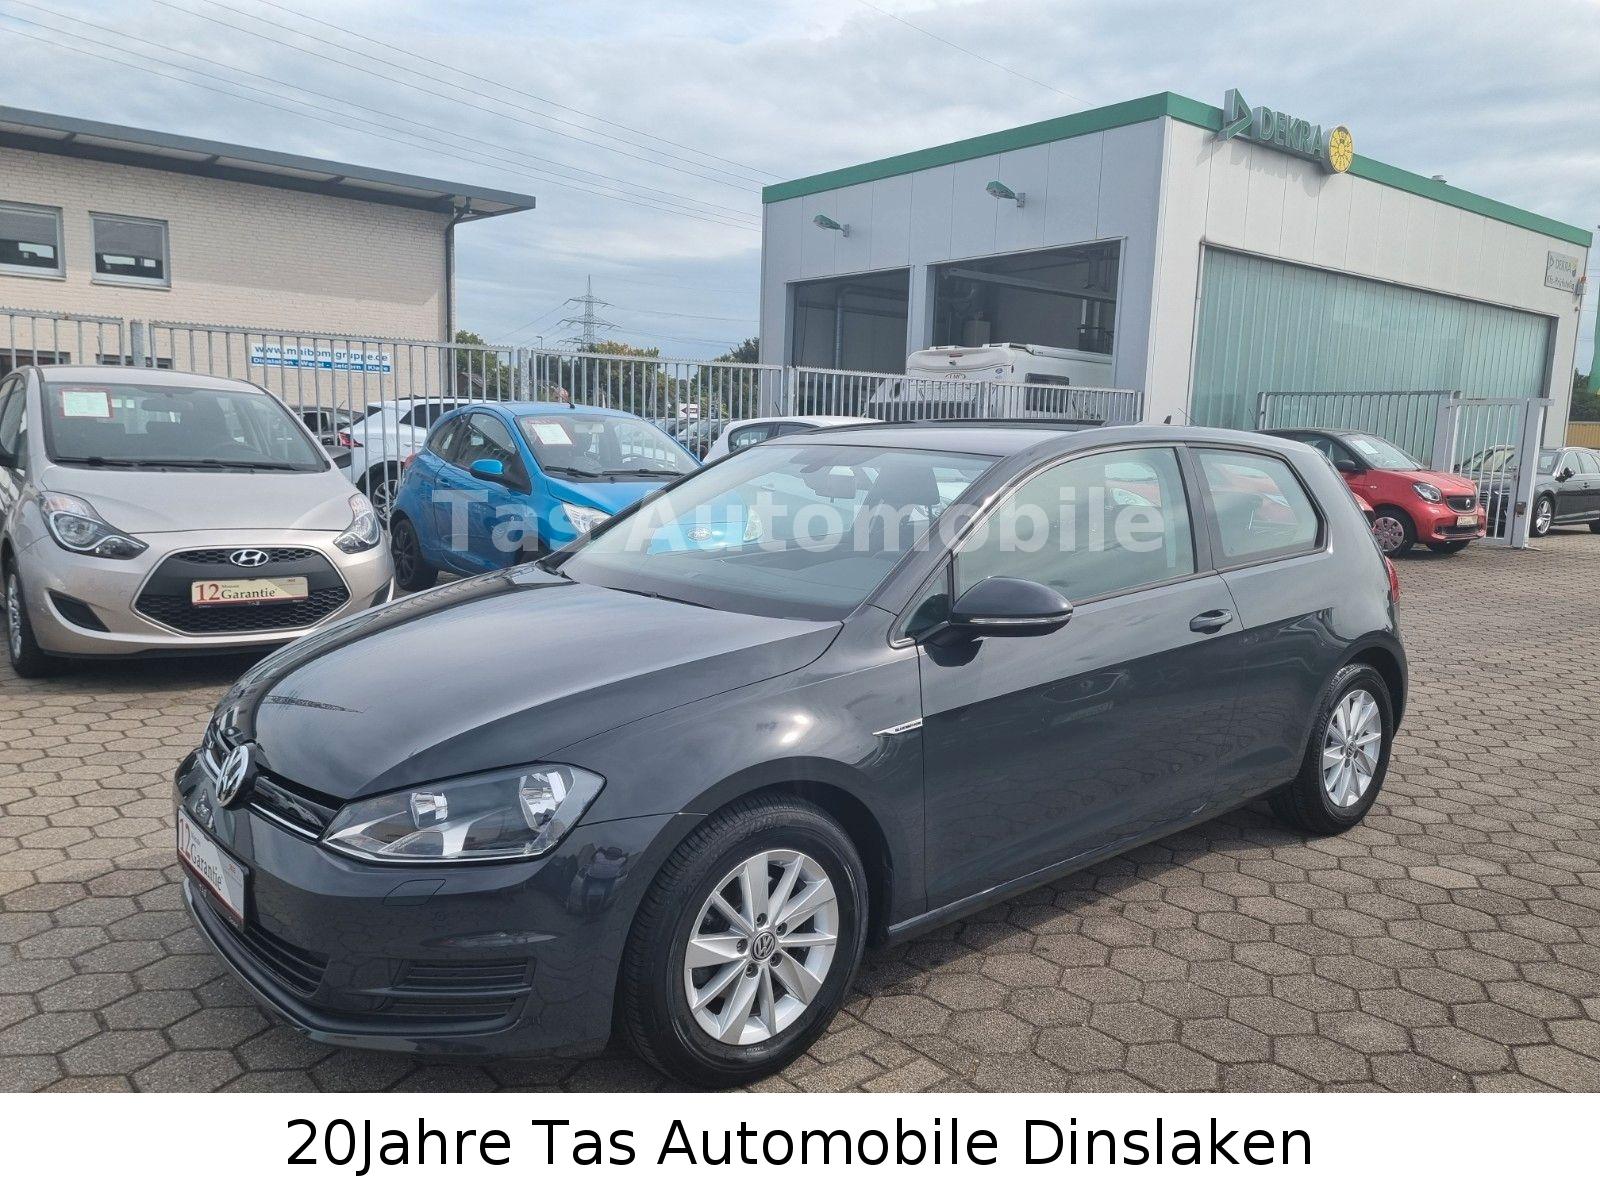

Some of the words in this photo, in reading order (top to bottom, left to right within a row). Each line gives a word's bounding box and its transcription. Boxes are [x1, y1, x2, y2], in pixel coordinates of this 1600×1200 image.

[1256, 106, 1325, 160] DEKRA
[195, 584, 220, 601] 12
[221, 588, 276, 600] Garantie
[190, 843, 223, 891] Garantie
